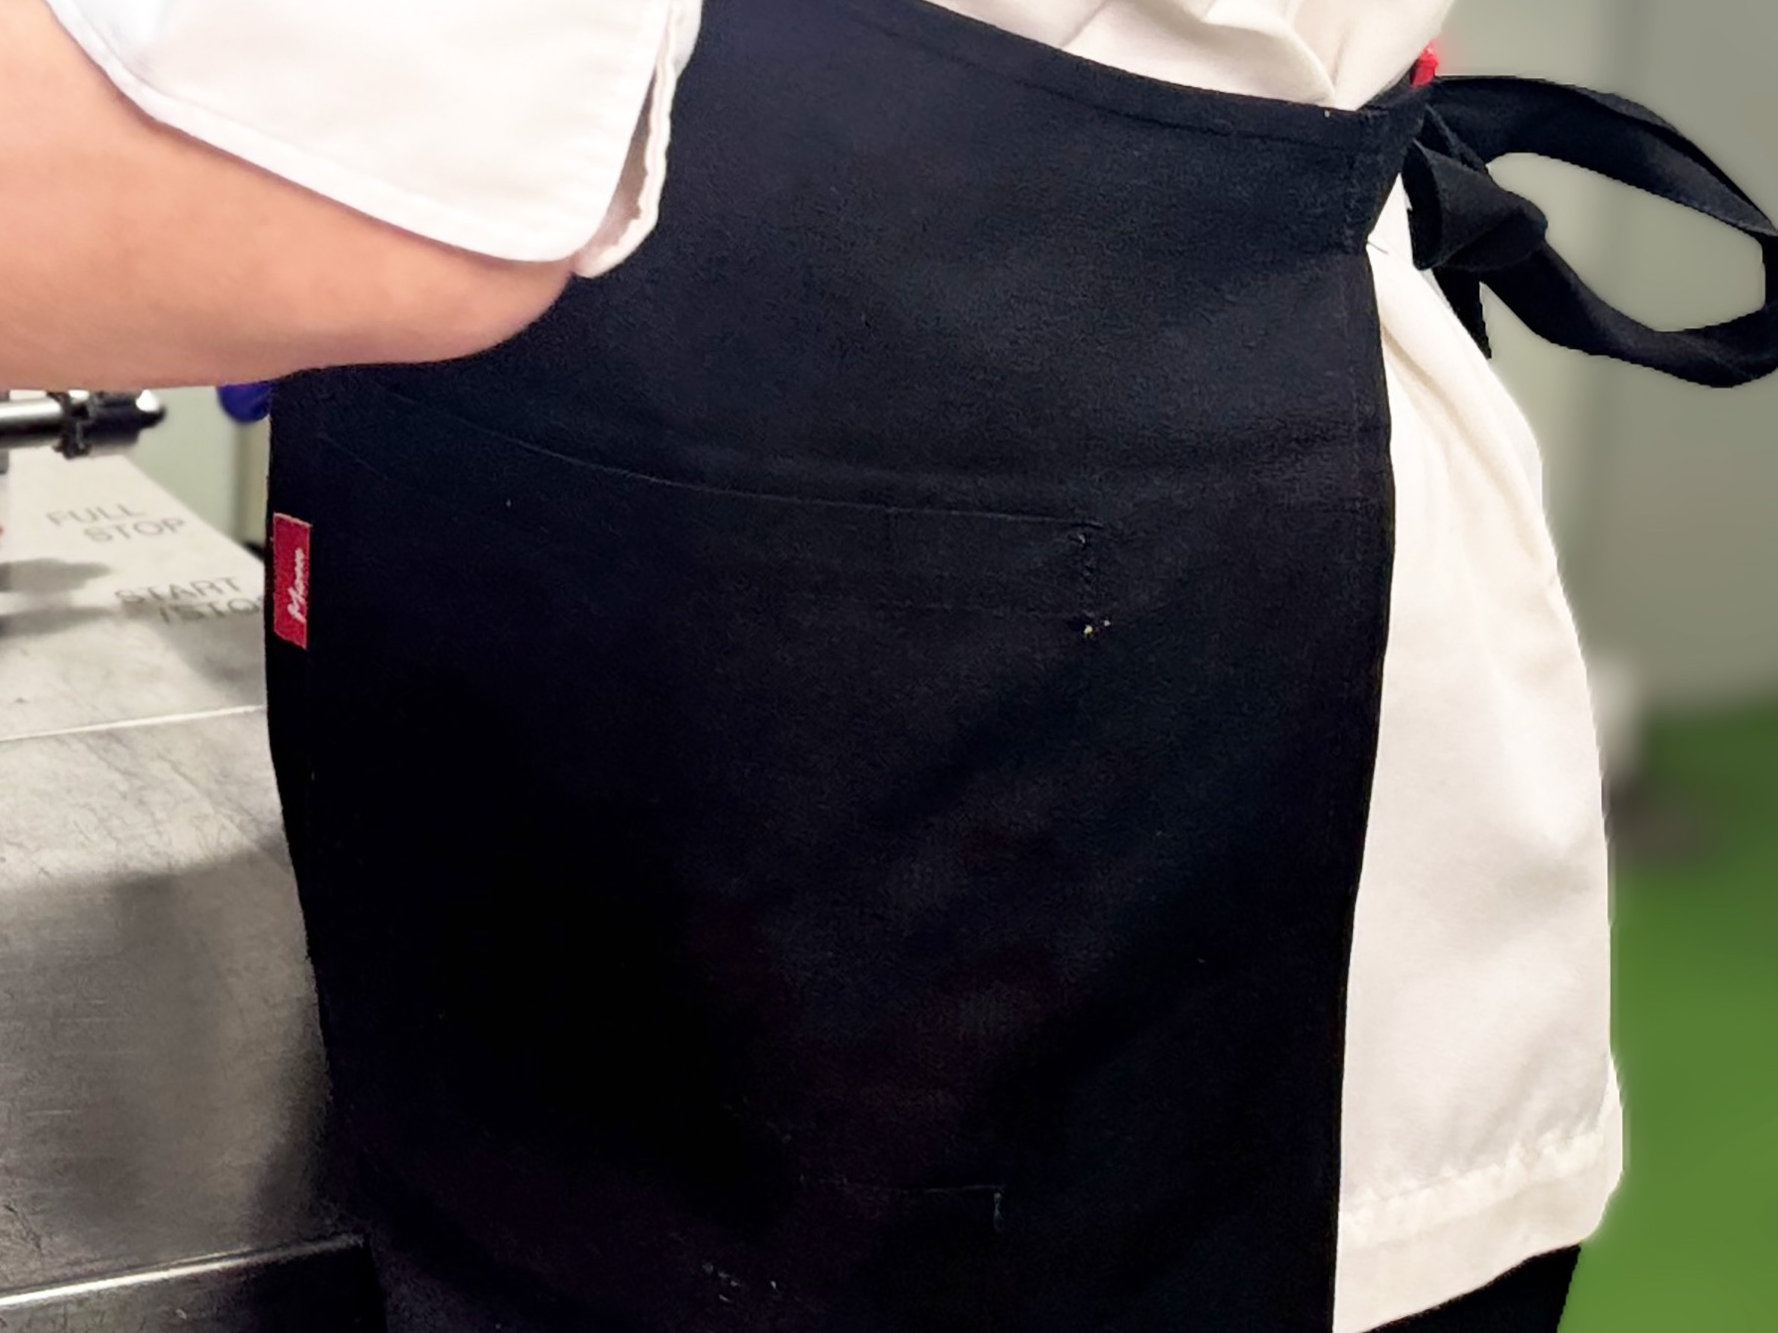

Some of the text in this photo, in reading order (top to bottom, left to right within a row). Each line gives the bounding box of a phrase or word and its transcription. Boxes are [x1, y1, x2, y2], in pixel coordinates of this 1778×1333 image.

[45, 503, 147, 527] FULL
[83, 517, 186, 542] STOP
[114, 576, 242, 604] START
[158, 597, 264, 626] /STO
